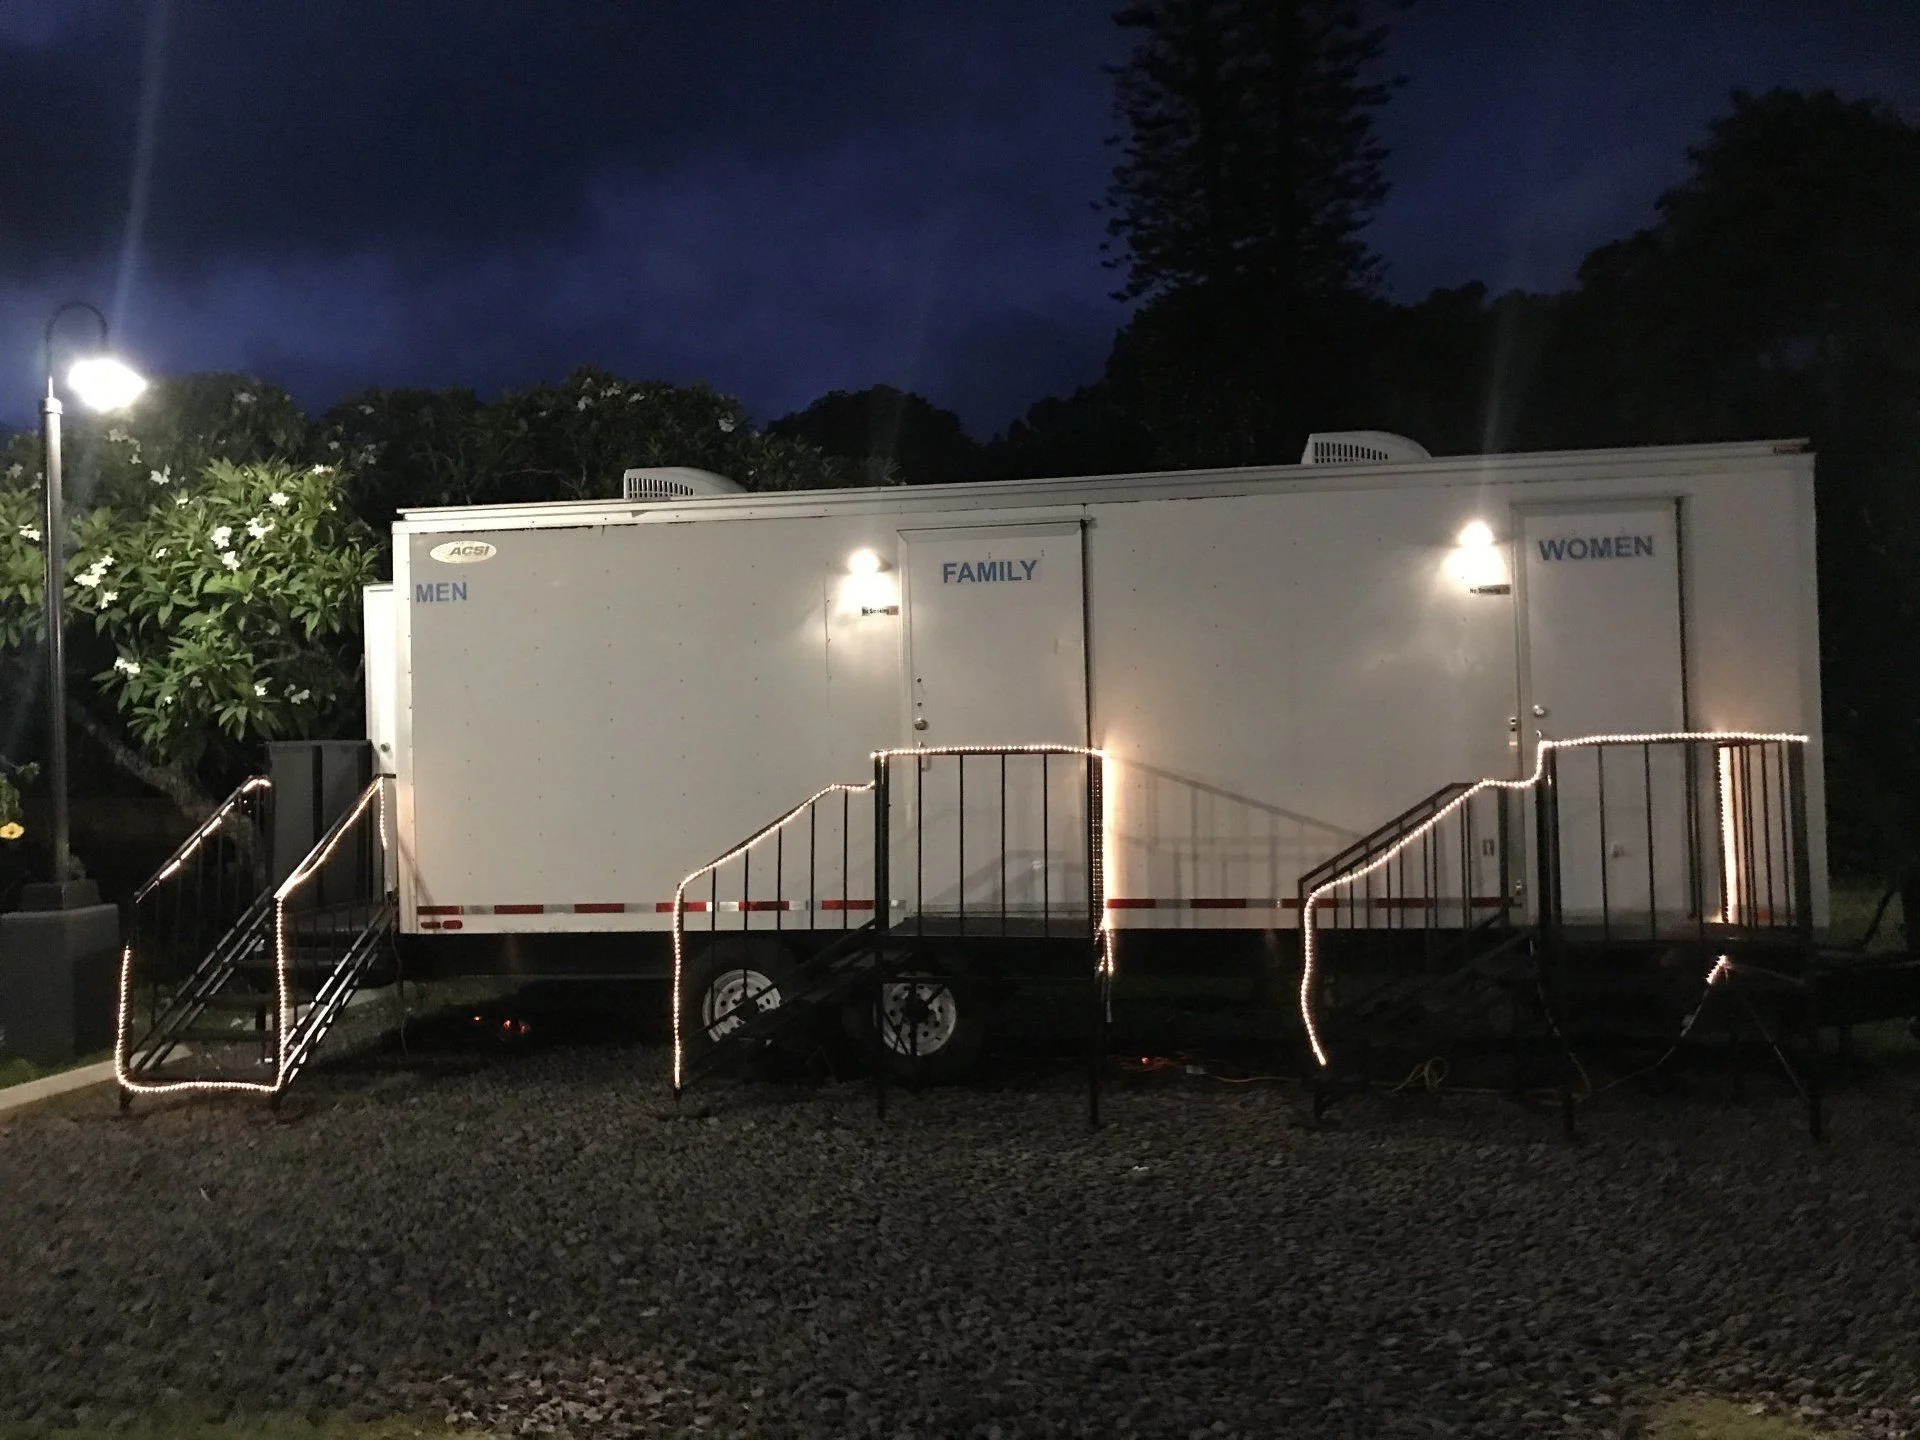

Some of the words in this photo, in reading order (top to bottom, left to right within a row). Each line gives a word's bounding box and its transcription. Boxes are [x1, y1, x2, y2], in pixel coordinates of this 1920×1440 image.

[449, 546, 490, 556] ACSI
[1538, 535, 1653, 560] WOMEN
[943, 560, 1038, 583] FAMILY
[416, 582, 467, 603] MEN
